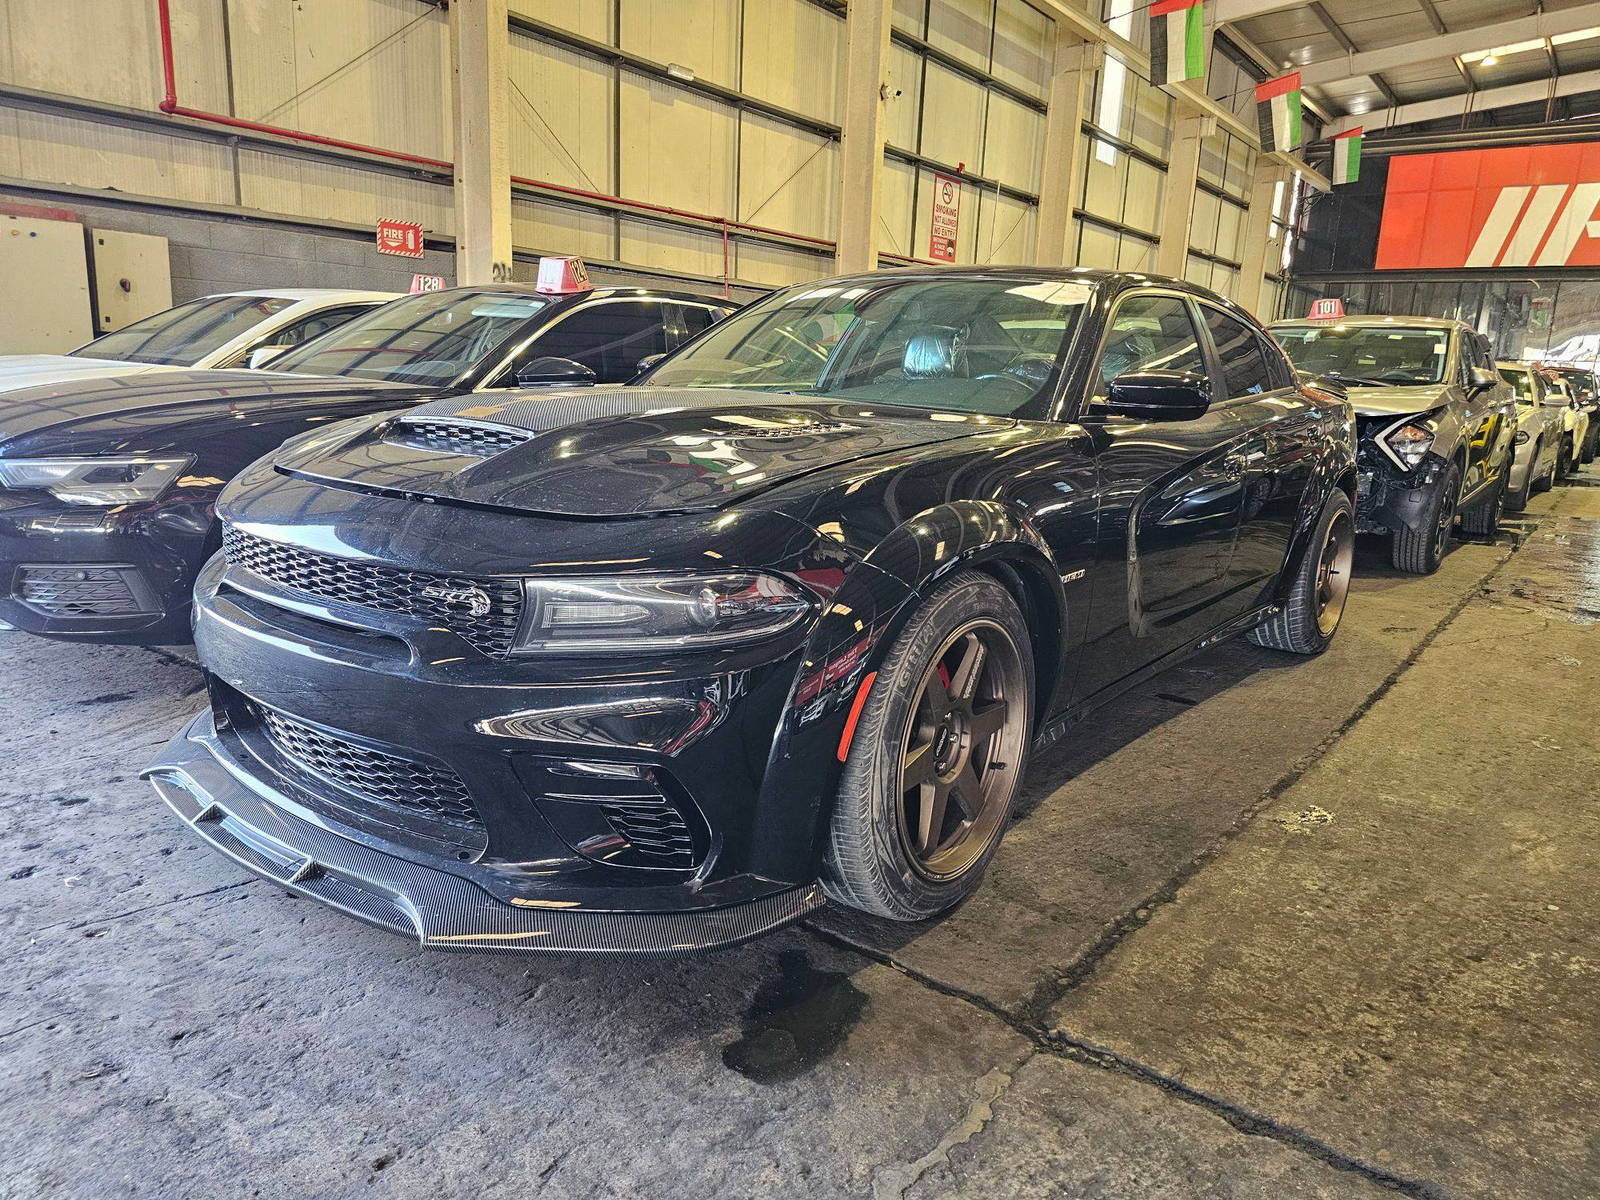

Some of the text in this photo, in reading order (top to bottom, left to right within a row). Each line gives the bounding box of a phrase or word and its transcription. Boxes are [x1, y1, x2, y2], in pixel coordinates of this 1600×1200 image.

[936, 204, 957, 217] SMOKING
[383, 227, 404, 240] FIRE
[941, 229, 955, 239] ENTRY
[418, 276, 439, 291] 128
[1318, 301, 1336, 314] 101
